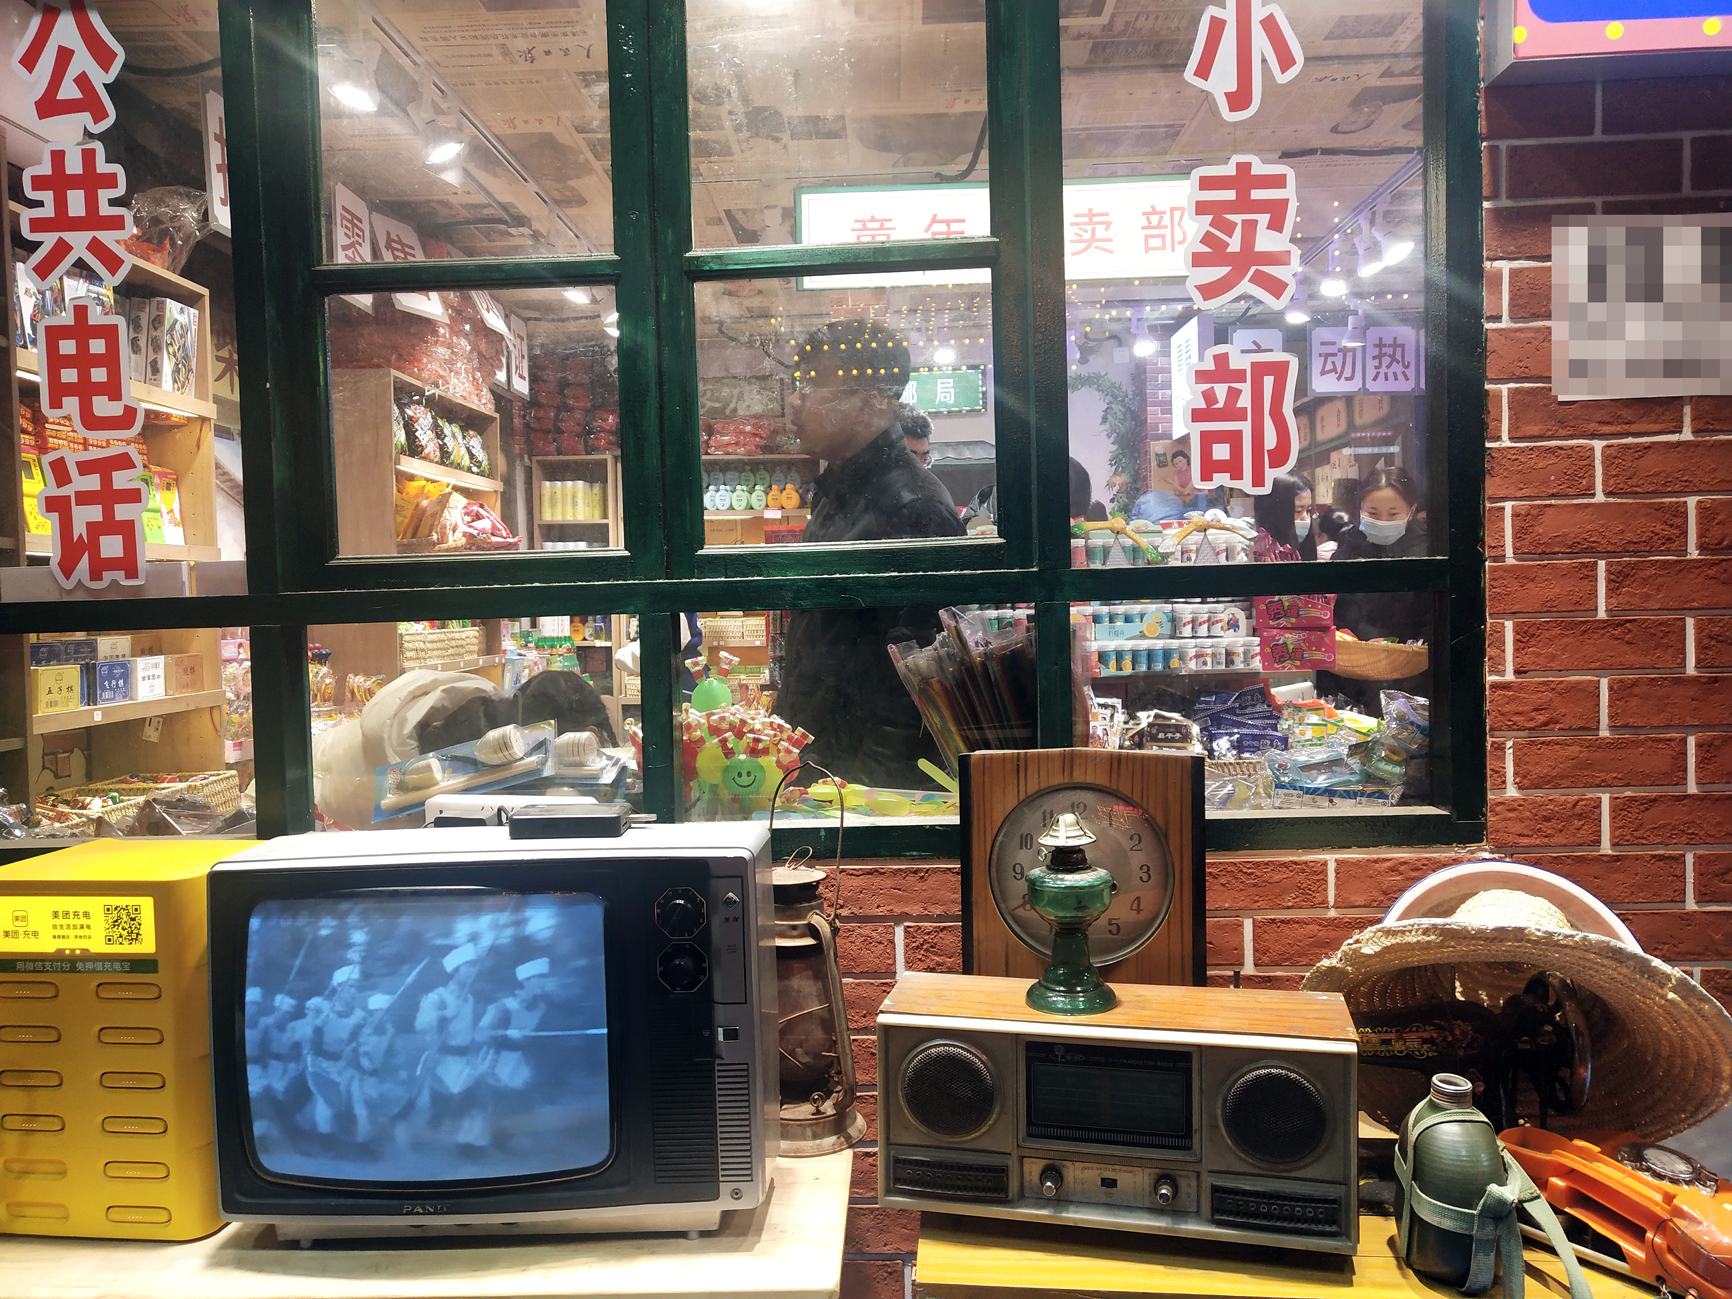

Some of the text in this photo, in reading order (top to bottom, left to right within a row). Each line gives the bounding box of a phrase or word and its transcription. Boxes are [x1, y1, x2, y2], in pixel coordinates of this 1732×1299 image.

[1191, 0, 1297, 488] 小卖部
[18, 2, 143, 581] 公共电话
[1019, 832, 1034, 850] 10
[1129, 834, 1143, 852] 2
[1012, 862, 1025, 881] 9
[1139, 864, 1151, 883] 3
[51, 910, 91, 920] 美团充电
[1129, 896, 1144, 915] 4
[1107, 917, 1121, 936] 5
